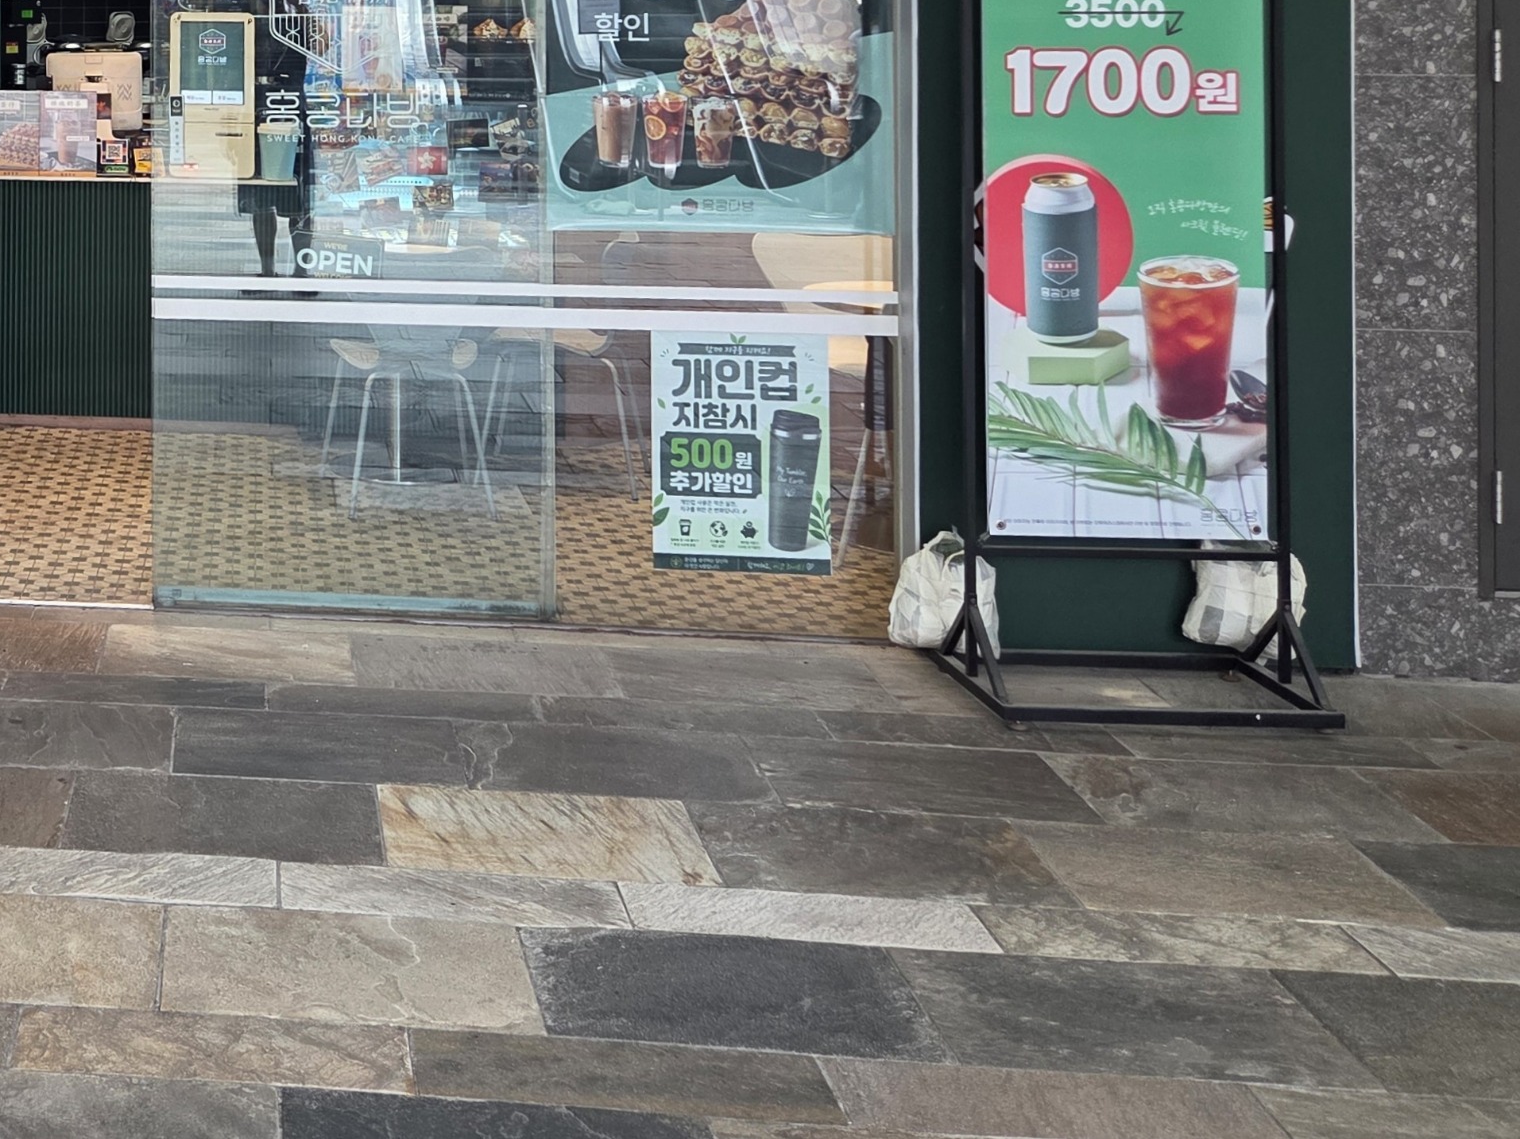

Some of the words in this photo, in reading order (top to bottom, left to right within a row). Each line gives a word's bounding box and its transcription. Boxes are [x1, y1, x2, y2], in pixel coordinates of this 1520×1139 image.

[594, 12, 650, 41] 할인
[1004, 45, 1241, 118] 1700원
[265, 88, 427, 129] 홍콩다방
[266, 134, 306, 143] SWEET
[311, 134, 346, 143] HONG
[389, 134, 420, 143] CAFE
[296, 247, 374, 277] OPEN
[671, 358, 798, 402] 개인컵
[671, 401, 758, 431] 지참시
[669, 437, 753, 471] 500원
[669, 470, 753, 495] 추가할인
